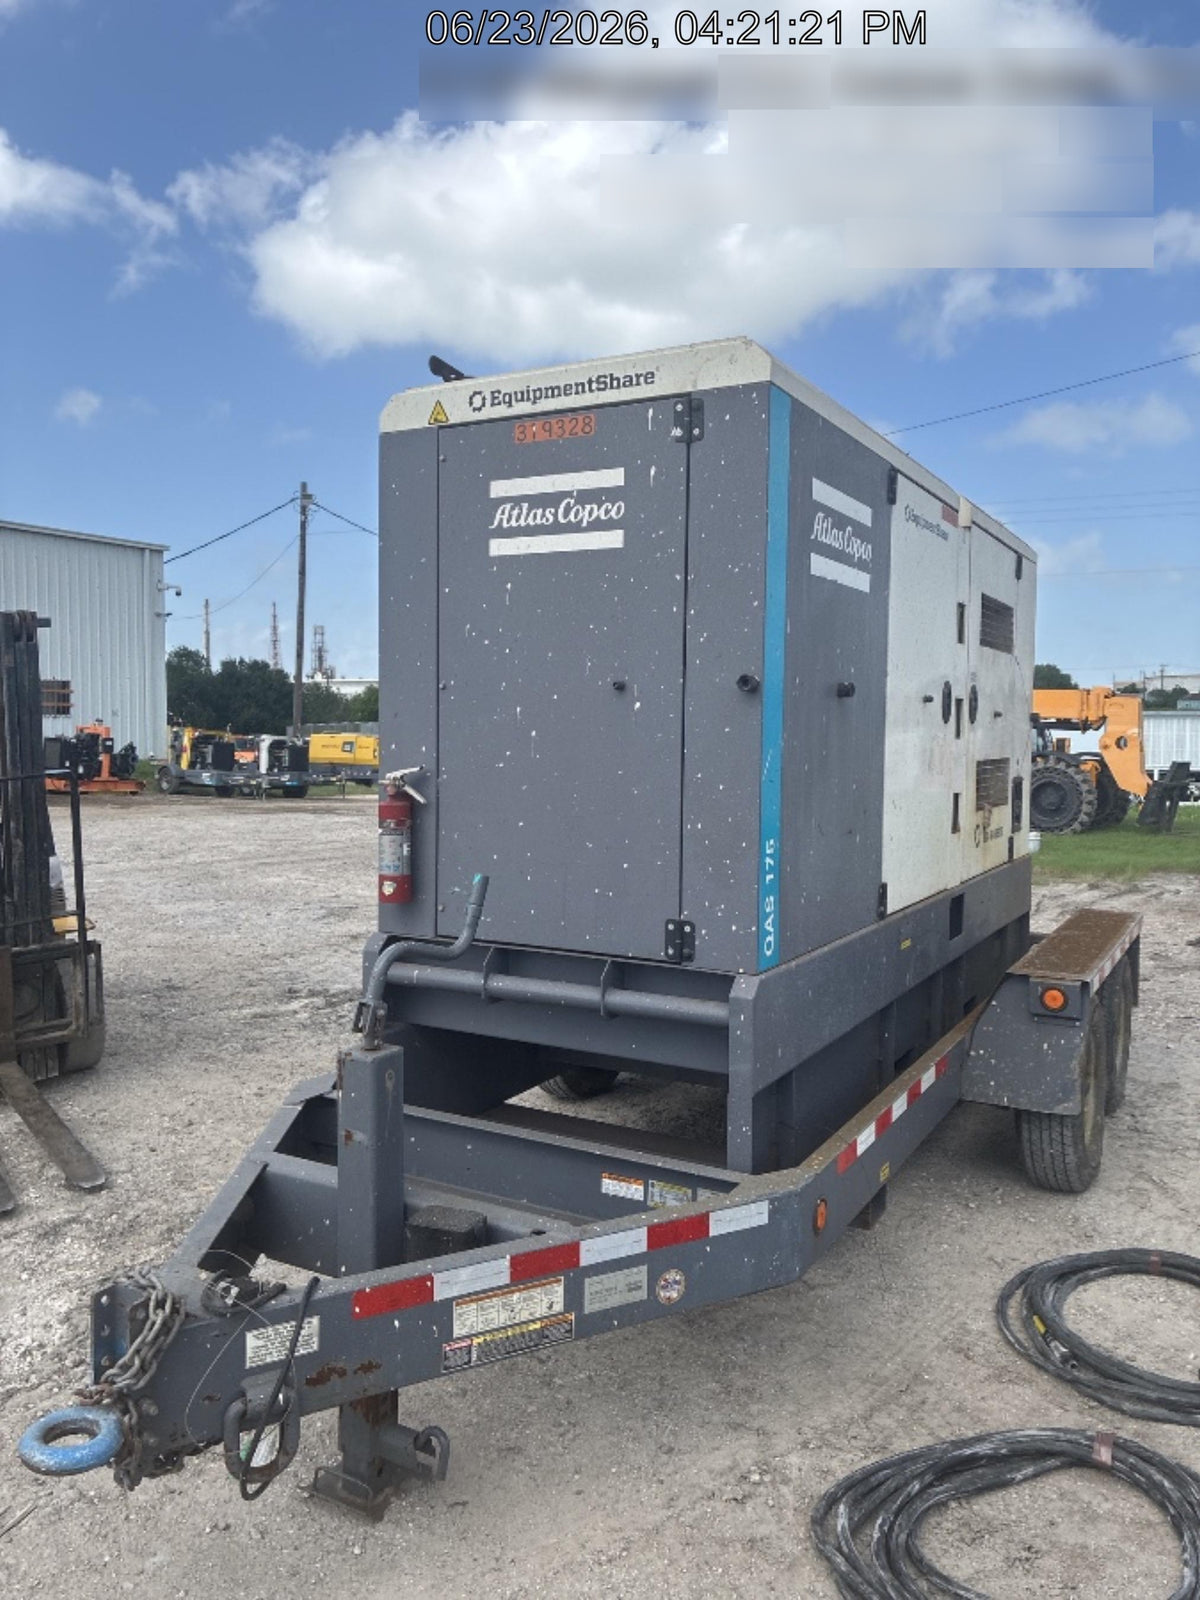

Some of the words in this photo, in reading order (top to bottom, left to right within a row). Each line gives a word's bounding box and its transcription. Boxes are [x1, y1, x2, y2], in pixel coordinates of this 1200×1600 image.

[490, 371, 656, 407] EquipmentShare
[516, 416, 593, 442] 319328
[489, 501, 554, 529] Atlas
[557, 498, 625, 525] Copco
[810, 511, 843, 551] Atlas
[843, 525, 872, 563] Copco
[764, 838, 774, 885] 175
